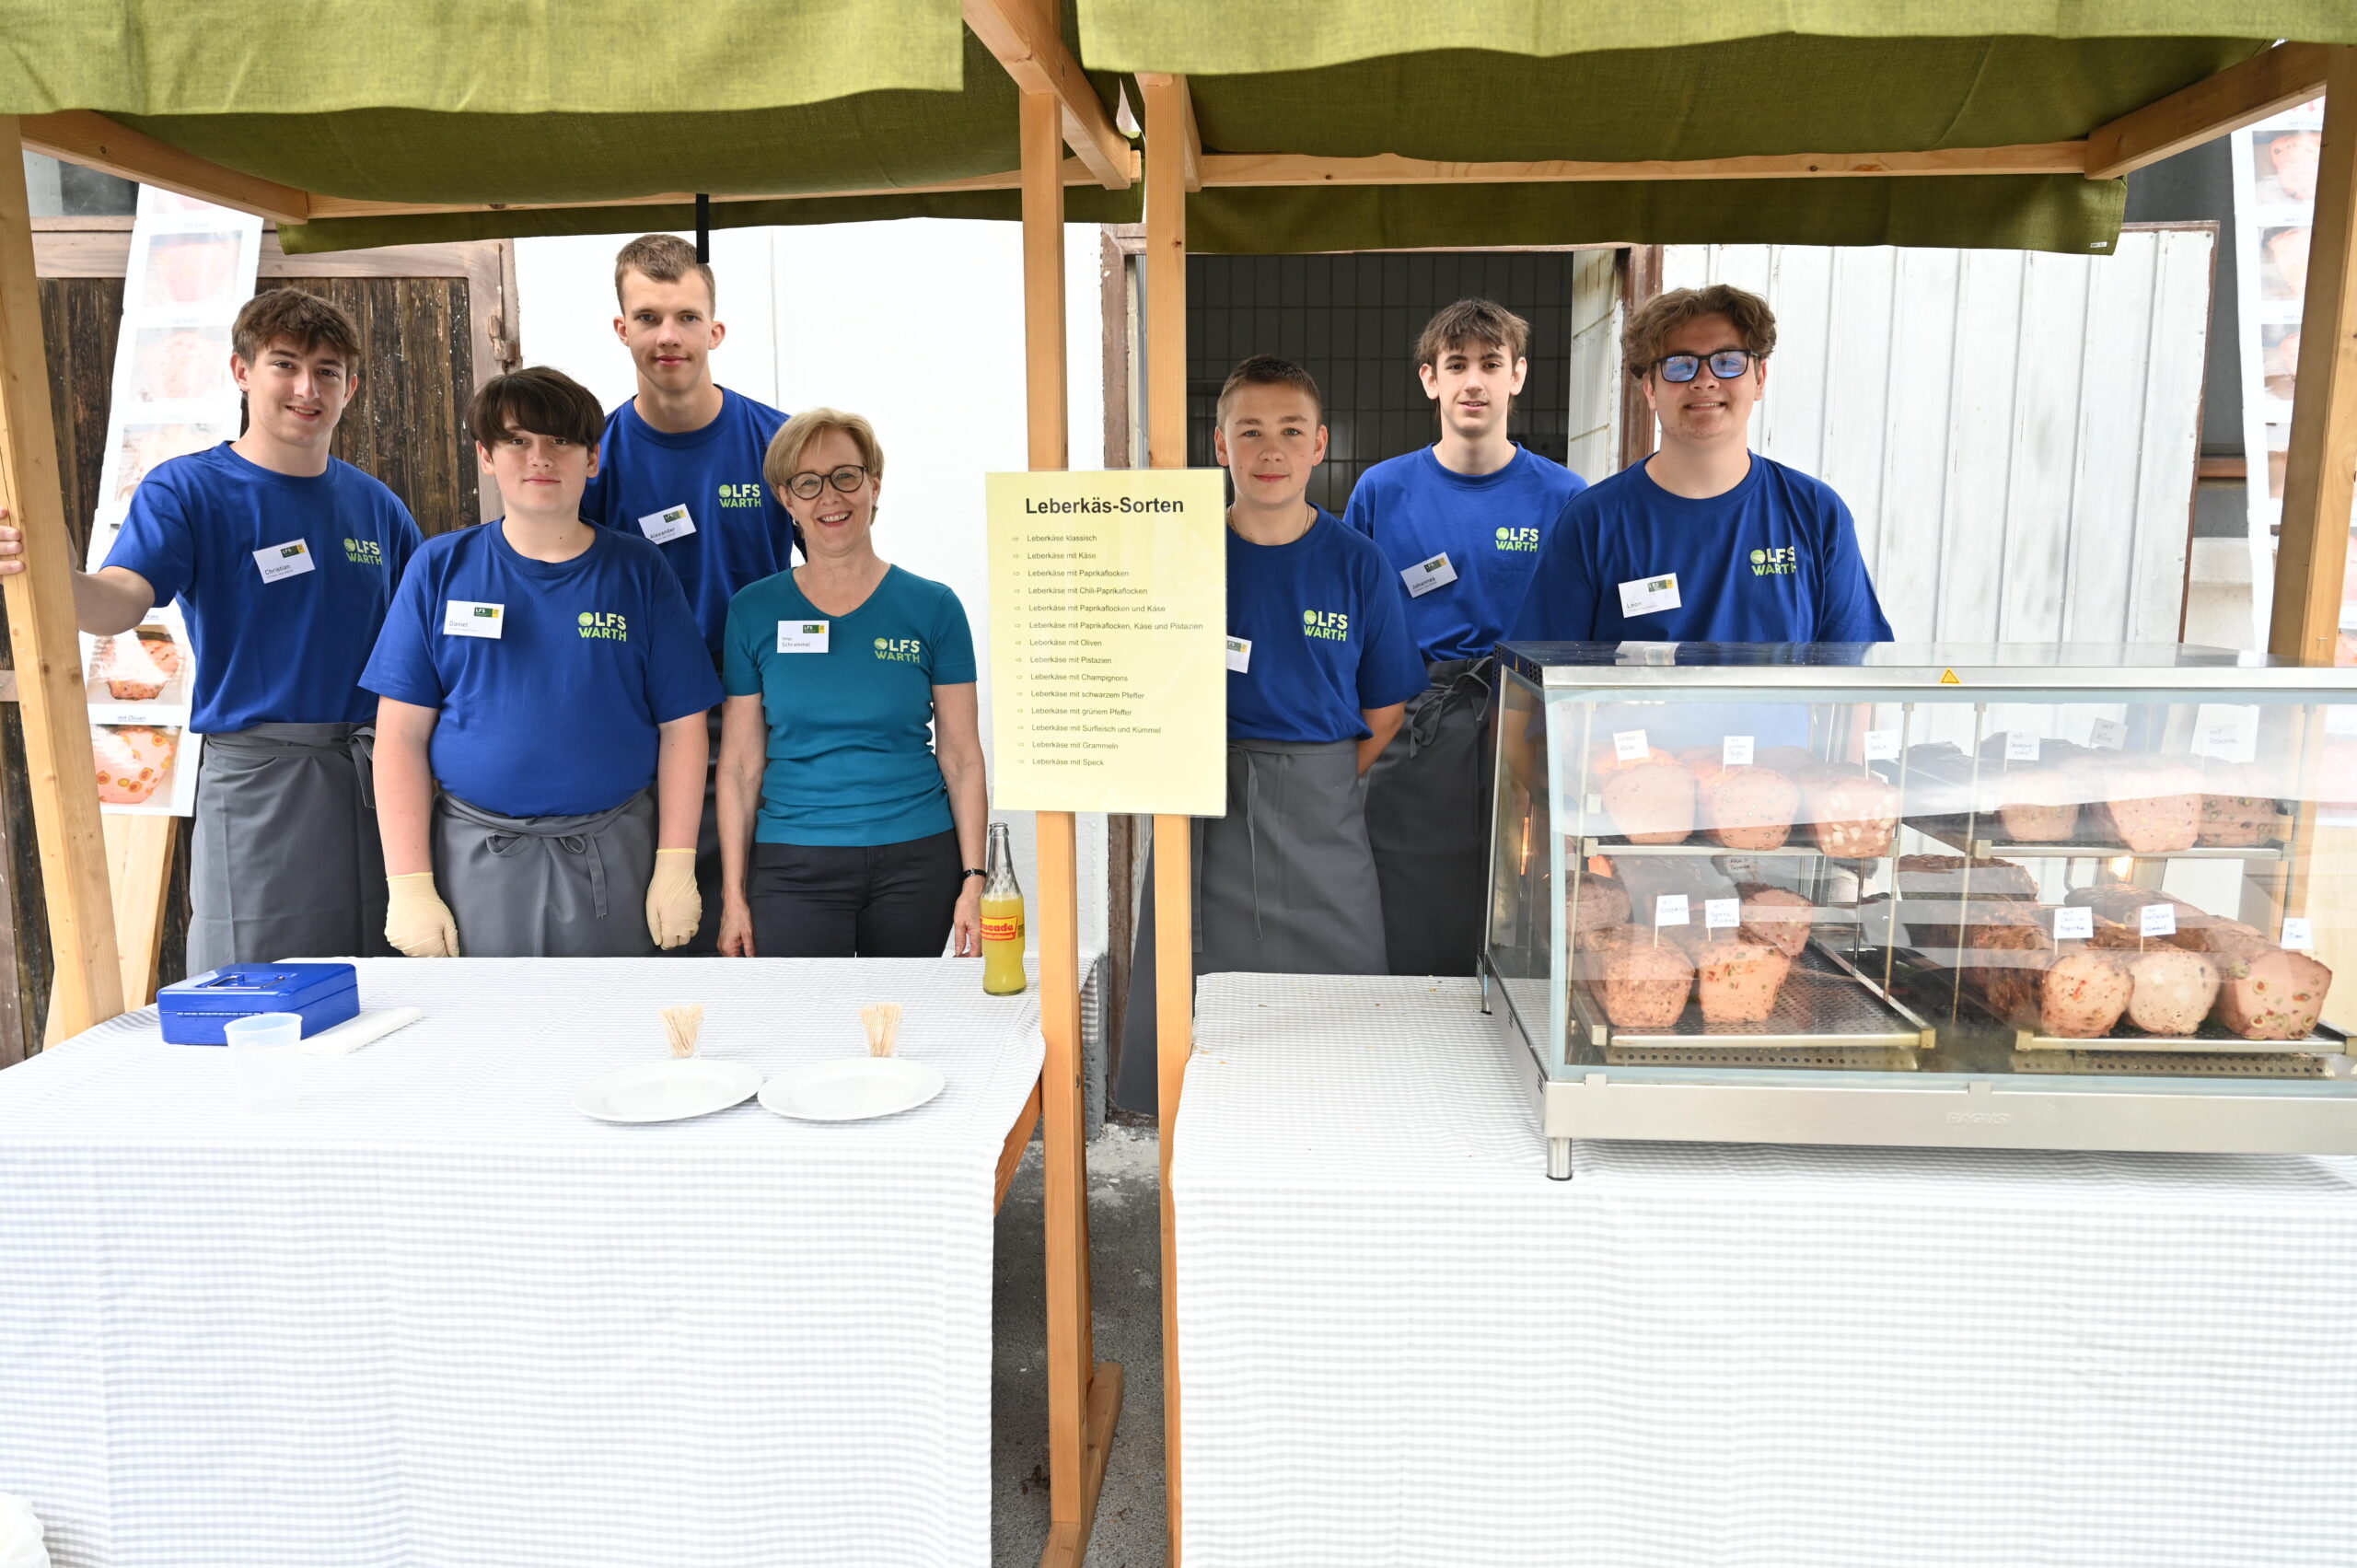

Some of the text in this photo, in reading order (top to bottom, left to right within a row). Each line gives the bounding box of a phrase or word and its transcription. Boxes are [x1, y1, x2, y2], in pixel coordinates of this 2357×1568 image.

[732, 484, 761, 498] LFS
[719, 498, 762, 508] WARTH
[1026, 495, 1184, 515] Leberkäs-Sorten
[650, 527, 676, 540] Alexander
[1027, 533, 1097, 543] Leberkäse klassisch
[1509, 528, 1539, 541] LFS
[355, 539, 381, 555] LFS
[1495, 540, 1538, 552] WARTH
[347, 552, 383, 565] WARTH
[1766, 546, 1795, 563] LFS
[264, 564, 292, 575] Christian
[1028, 569, 1130, 579] Leberkäse mit Paprikaflocken
[1751, 563, 1797, 575] WARTH
[1412, 577, 1435, 589] Johannes
[1028, 587, 1066, 595] Leberkäse
[1079, 587, 1147, 597] Chili-Paprikaflocken
[1079, 604, 1130, 613] Paprikaflocken
[1132, 604, 1145, 612] und
[595, 611, 627, 631] LFS
[1028, 621, 1066, 630] Leberkäse
[1068, 621, 1079, 630] mit
[1080, 621, 1132, 632] Paprikaflocken,
[1155, 622, 1168, 631] und
[1170, 622, 1203, 631] Pistazien
[1318, 611, 1348, 630] LFS
[578, 626, 627, 643] WARTH
[1304, 625, 1347, 642] WARTH
[889, 639, 921, 653] LFS
[1029, 638, 1103, 647] Leberkäse mit Oliven
[874, 650, 921, 663] WARTH
[1080, 656, 1112, 664] Pistazien
[1030, 673, 1067, 681] Leberkäse
[1081, 673, 1128, 683] Champignons
[1031, 690, 1067, 698] Leberkäse
[1081, 691, 1120, 699] schwarzem
[1082, 708, 1108, 716] grünem
[1109, 708, 1132, 716] Pfeffer
[1032, 724, 1068, 732] Leberkäse
[1032, 741, 1068, 749] Leberkäse
[1083, 741, 1118, 750] Grammeln
